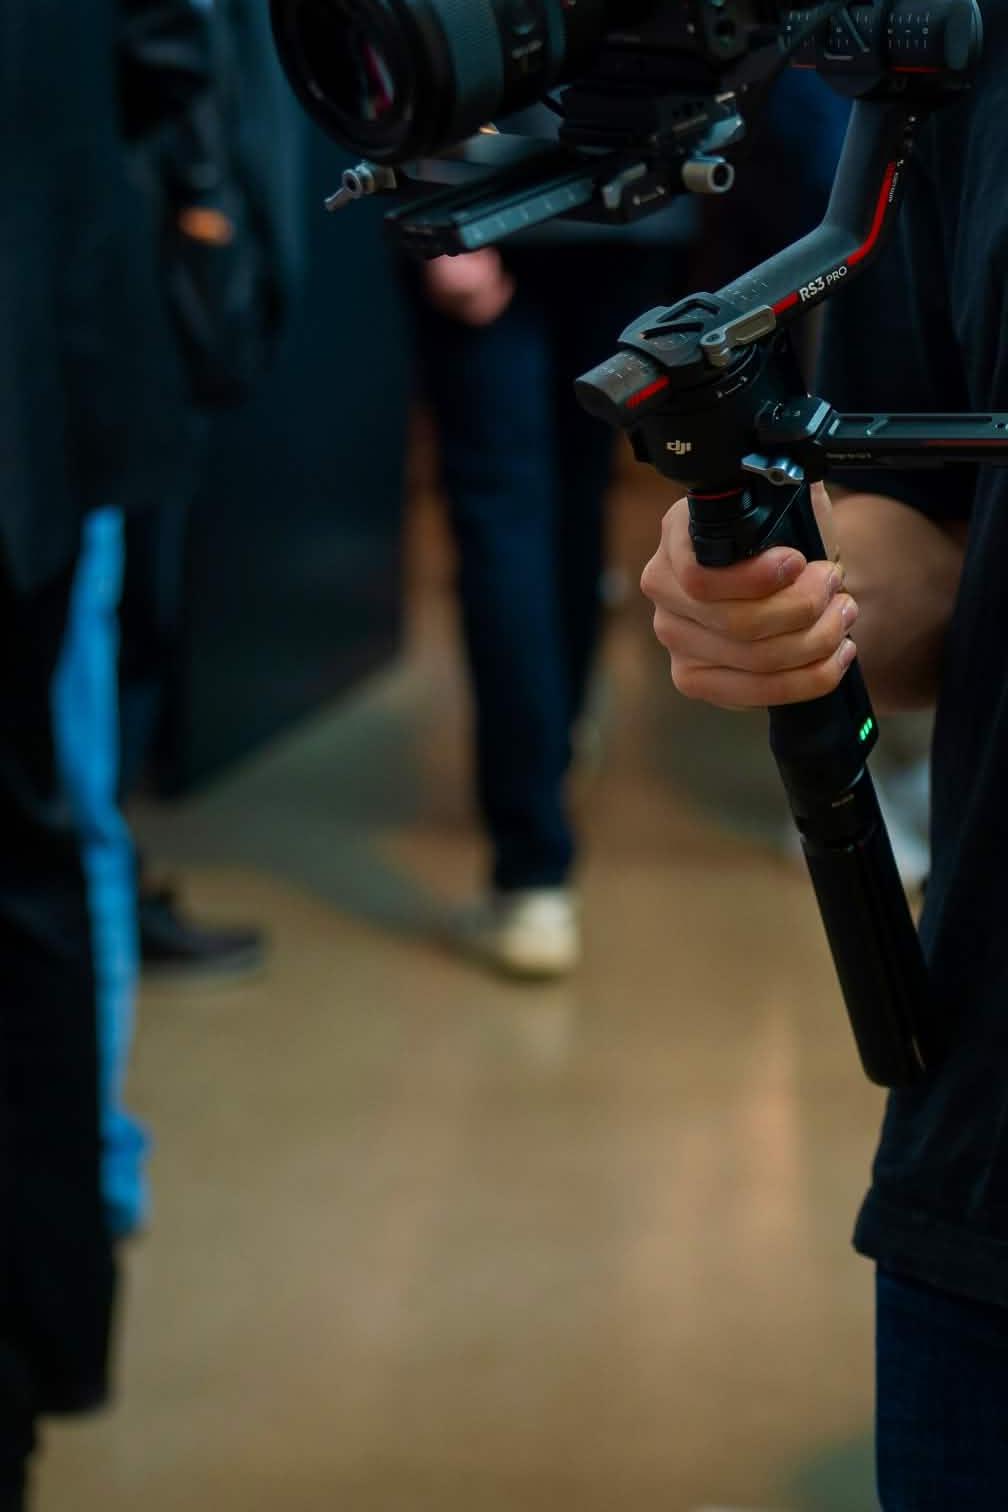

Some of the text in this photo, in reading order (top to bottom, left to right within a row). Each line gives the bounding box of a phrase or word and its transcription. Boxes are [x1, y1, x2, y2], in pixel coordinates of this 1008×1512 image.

[799, 265, 848, 302] RS3 PRO
[666, 439, 692, 455] dji
